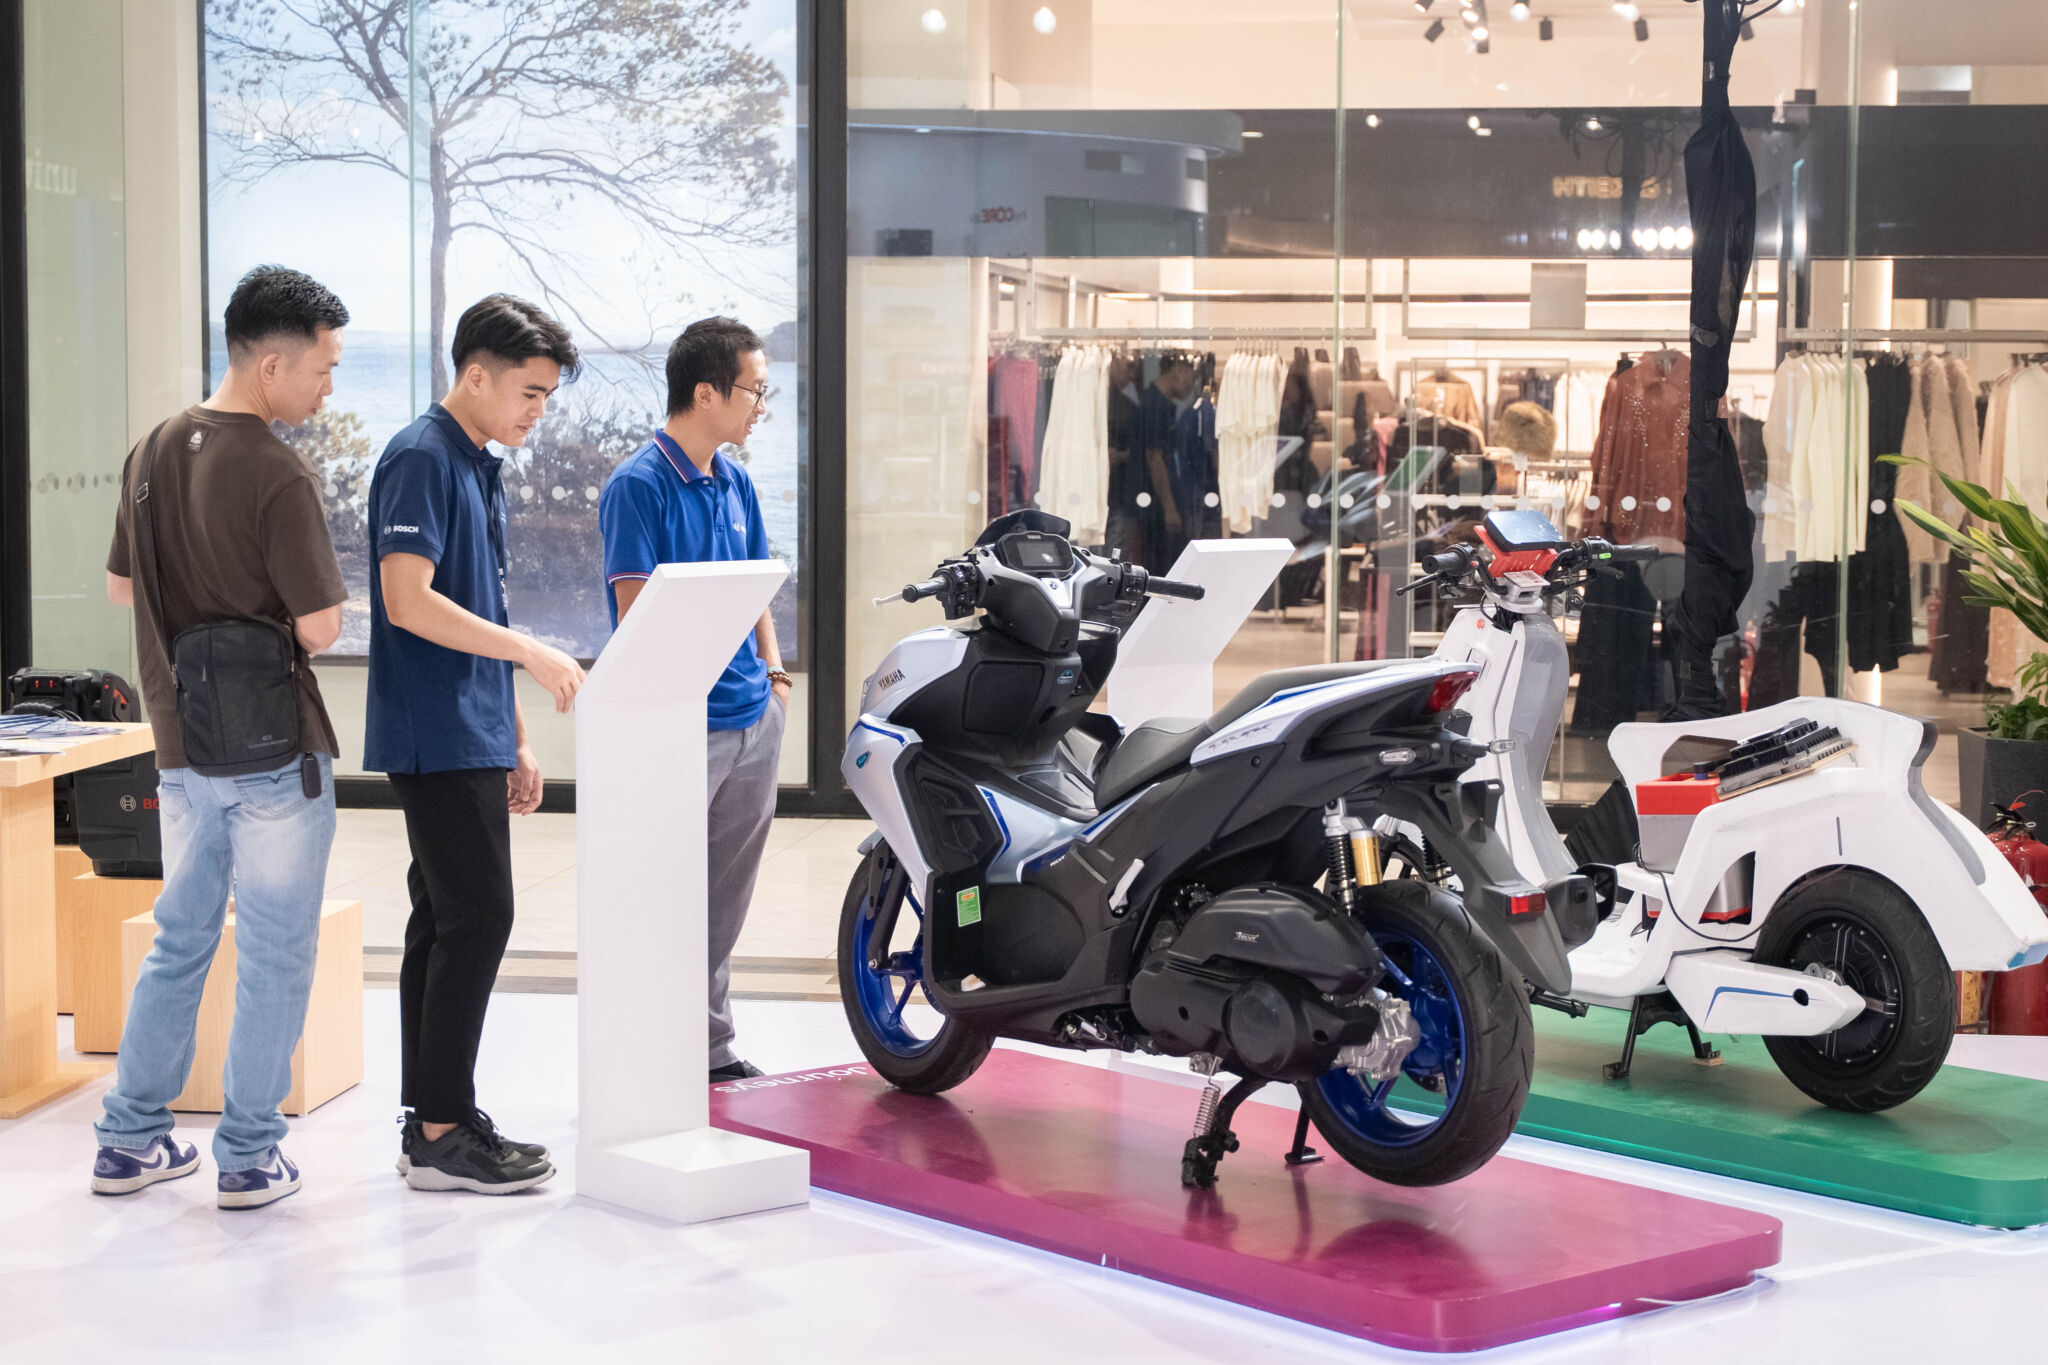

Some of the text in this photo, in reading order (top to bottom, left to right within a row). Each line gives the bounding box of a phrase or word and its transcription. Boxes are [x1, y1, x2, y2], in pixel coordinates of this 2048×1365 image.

[393, 525, 419, 534] BOSCH
[878, 668, 906, 691] YAMAHA
[143, 798, 160, 810] BO
[714, 1066, 869, 1093] Journeys
